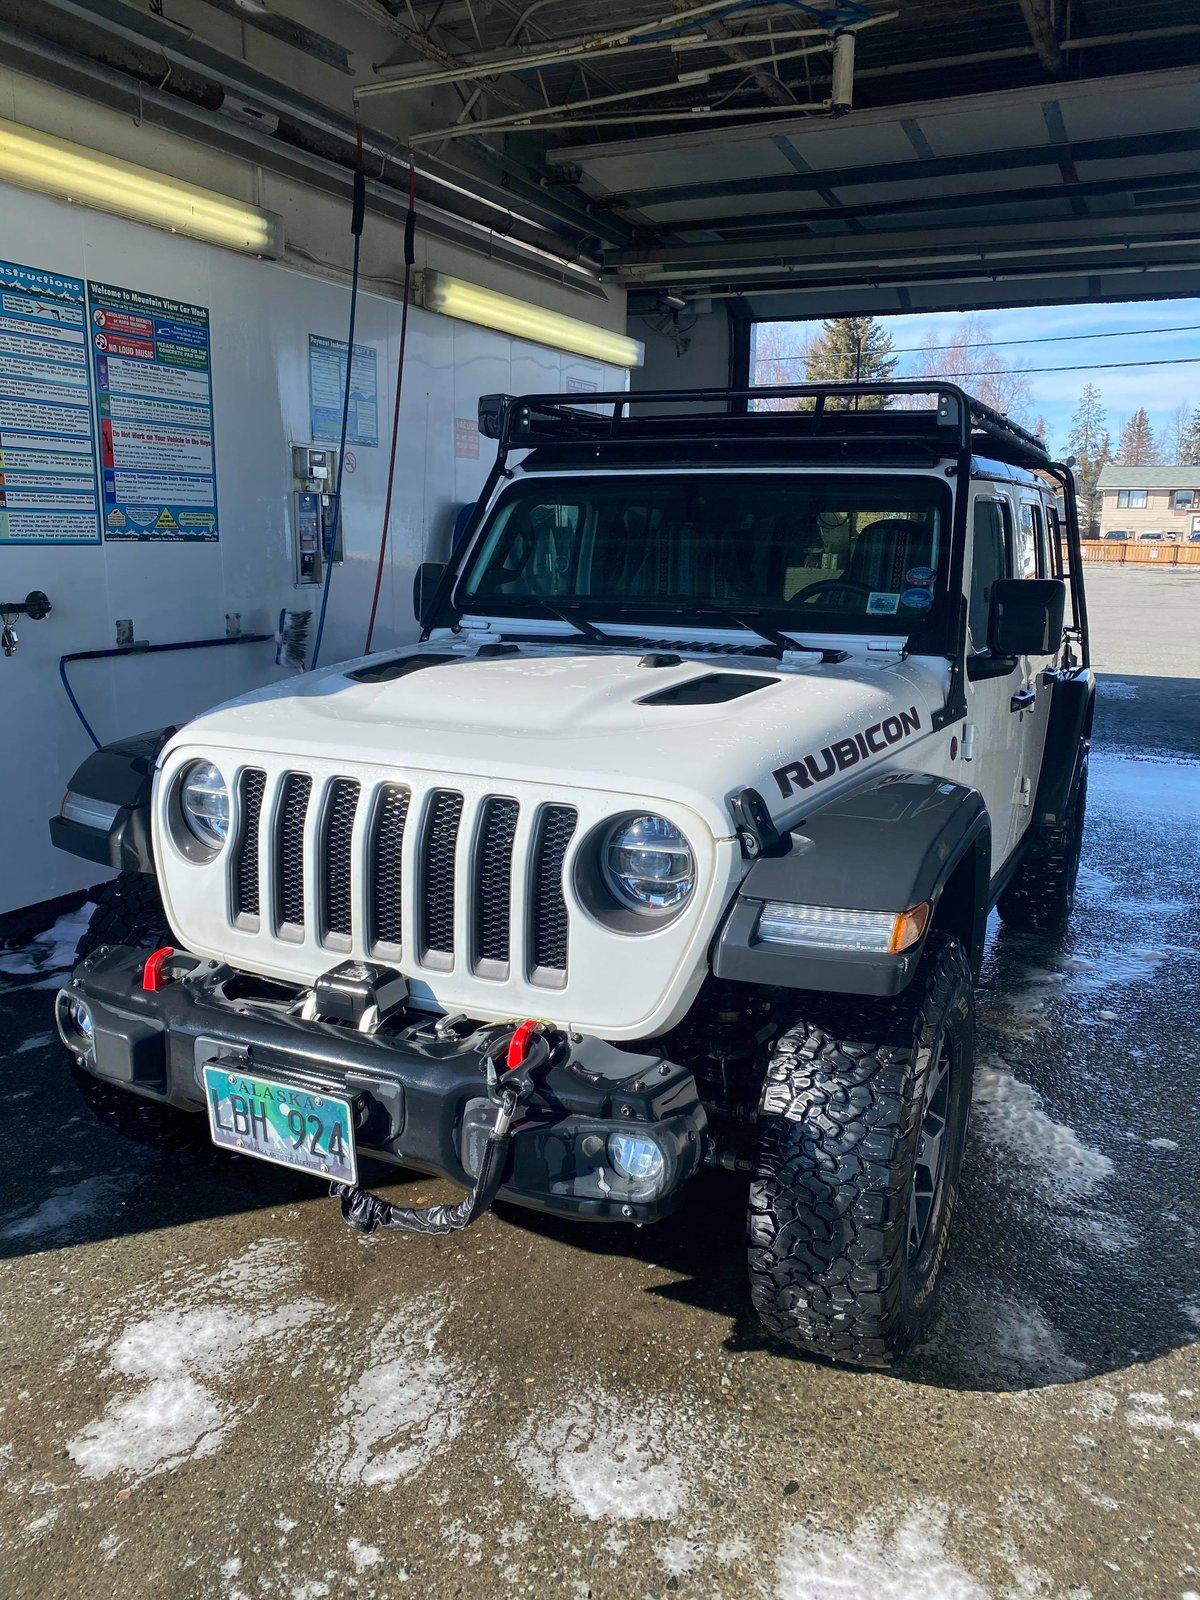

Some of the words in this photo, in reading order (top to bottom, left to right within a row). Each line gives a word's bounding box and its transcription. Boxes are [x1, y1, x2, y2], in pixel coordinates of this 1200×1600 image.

[90, 283, 120, 298] Welcome
[122, 290, 129, 300] to
[131, 293, 161, 307] Mountain
[163, 300, 178, 311] View
[179, 304, 190, 314] Car
[191, 306, 206, 317] Wash
[108, 343, 117, 352] NO
[118, 345, 134, 355] LOUD
[135, 348, 153, 358] MUSIC
[121, 430, 130, 438] Not
[166, 435, 183, 443] Vehicle
[772, 706, 922, 800] RUBICON
[238, 1080, 316, 1111] ALASKA
[211, 1088, 269, 1143] LBH
[287, 1109, 347, 1166] 924
